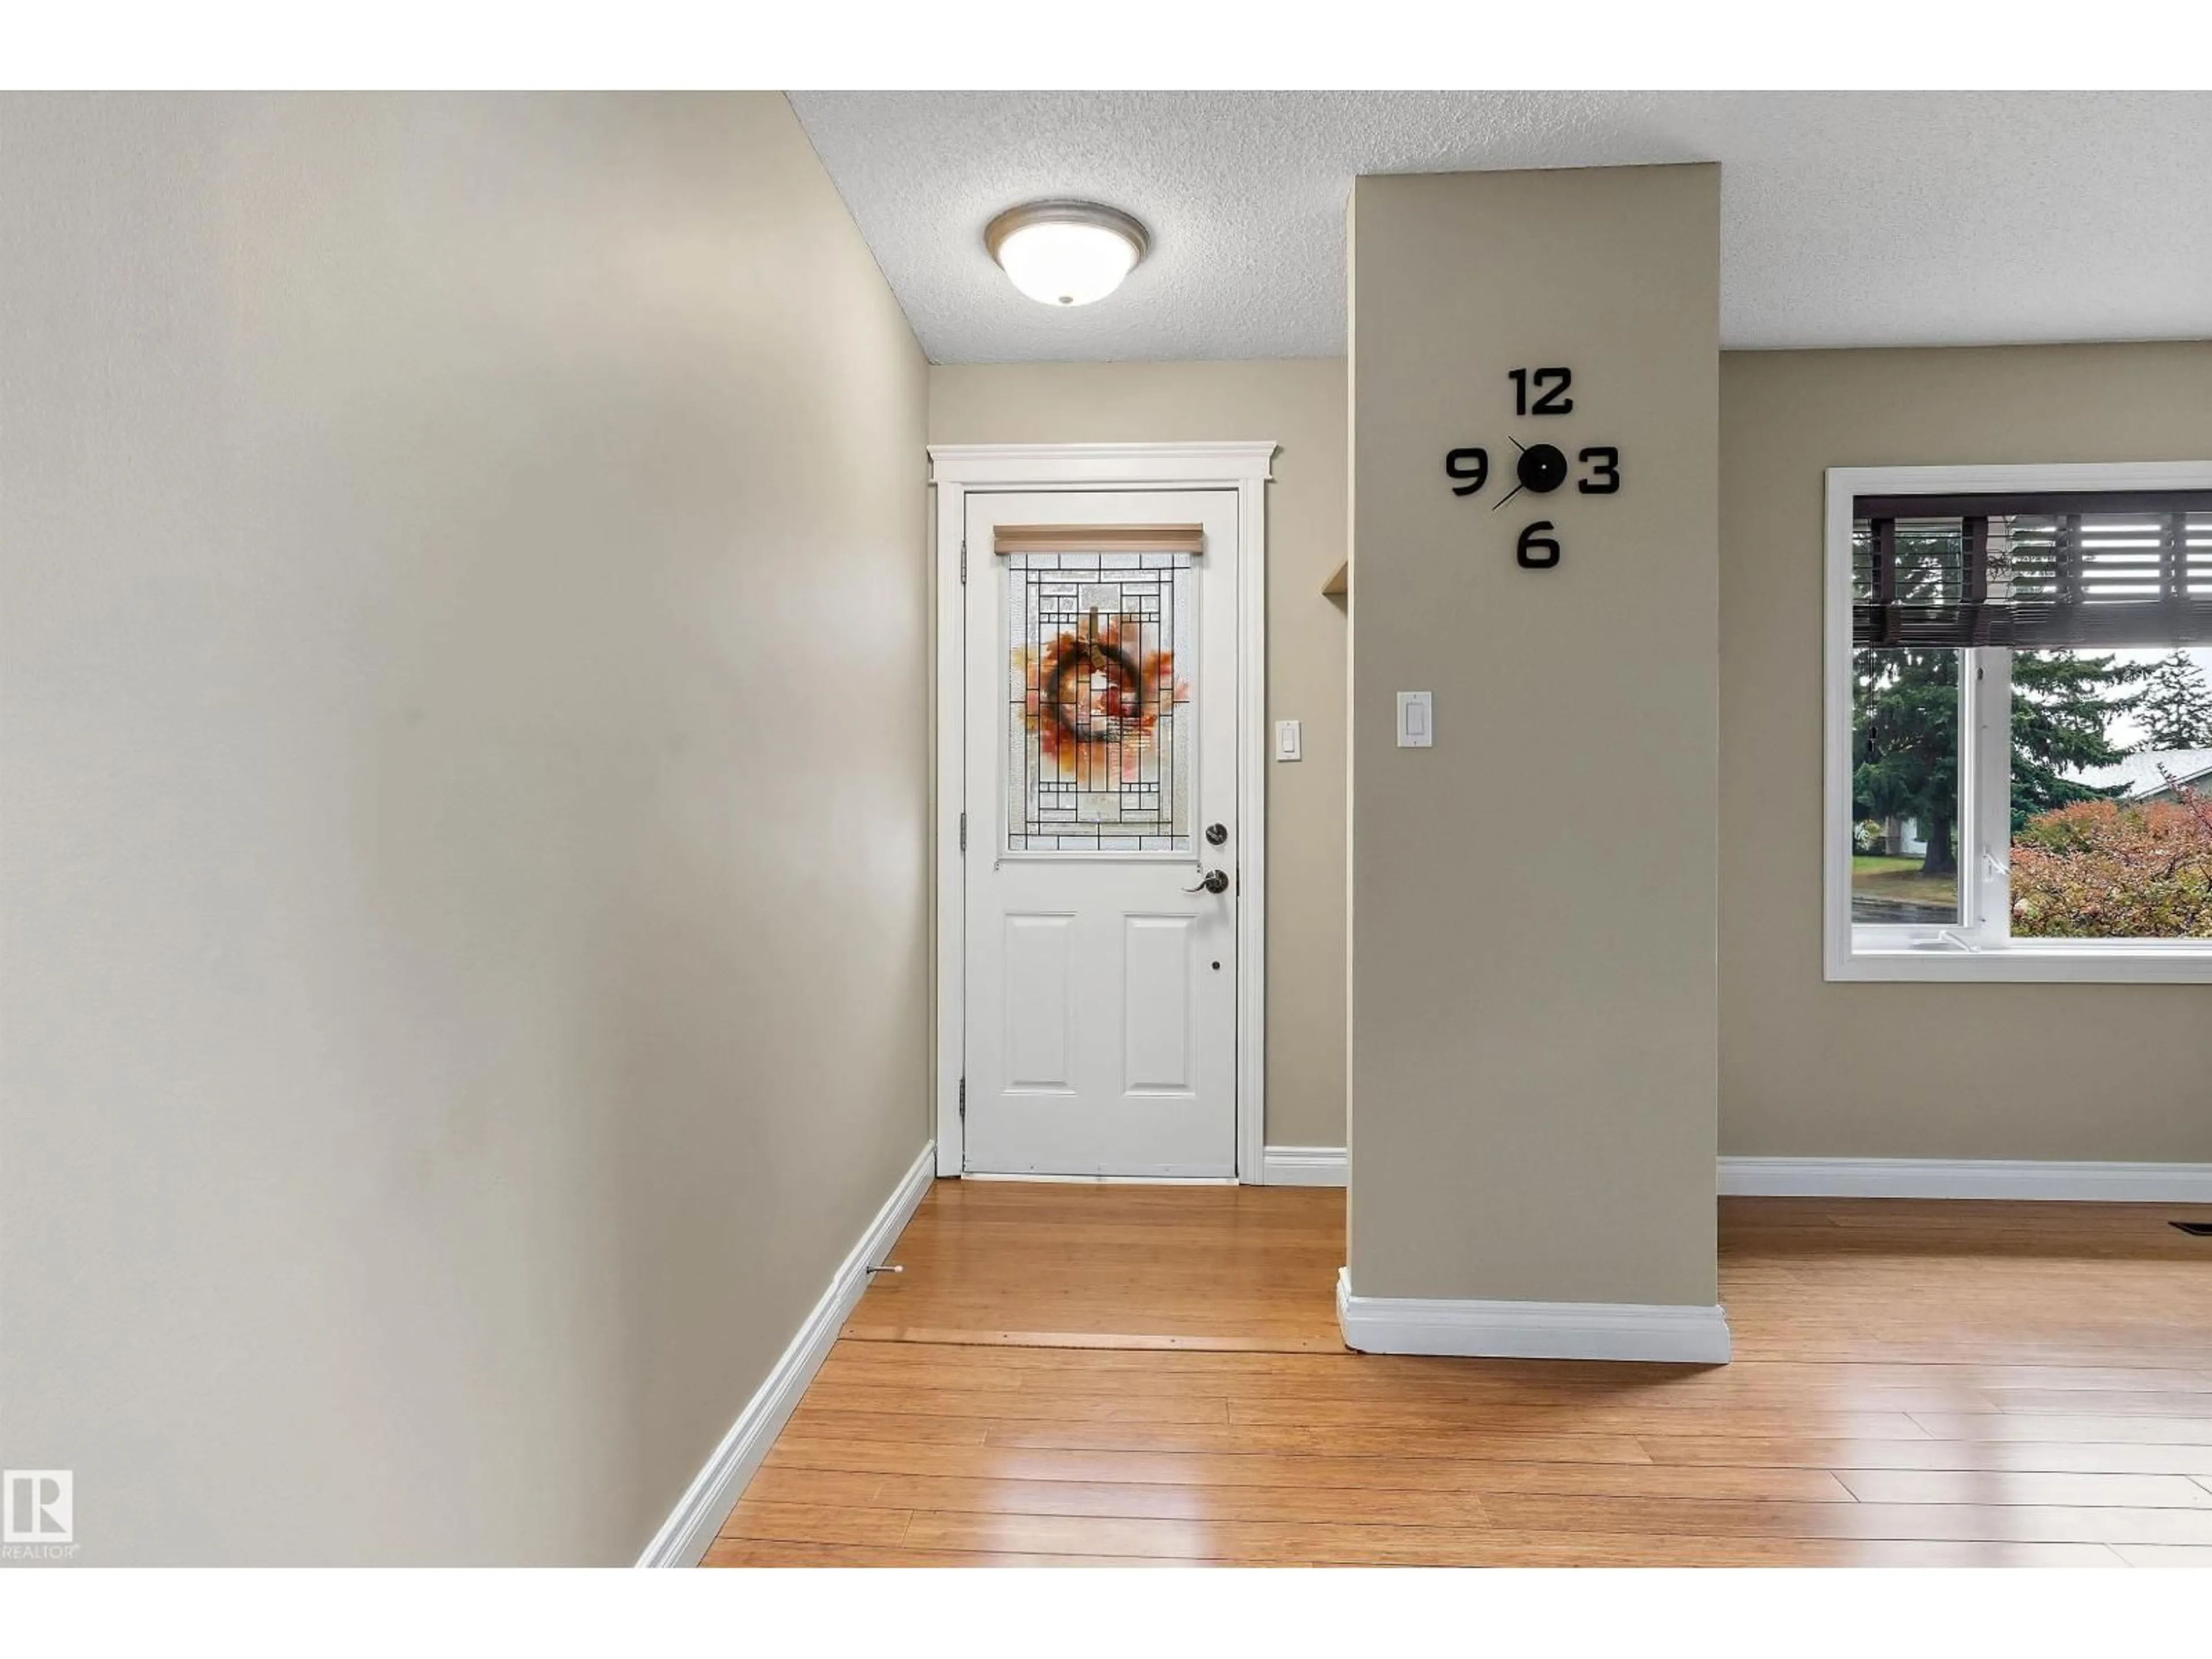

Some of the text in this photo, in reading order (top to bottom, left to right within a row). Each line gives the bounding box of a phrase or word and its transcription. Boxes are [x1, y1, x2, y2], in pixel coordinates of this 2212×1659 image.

[1508, 368, 1574, 416] 12
[1445, 448, 1488, 497] 9
[1578, 446, 1620, 495] 3
[1516, 521, 1560, 569] 6
